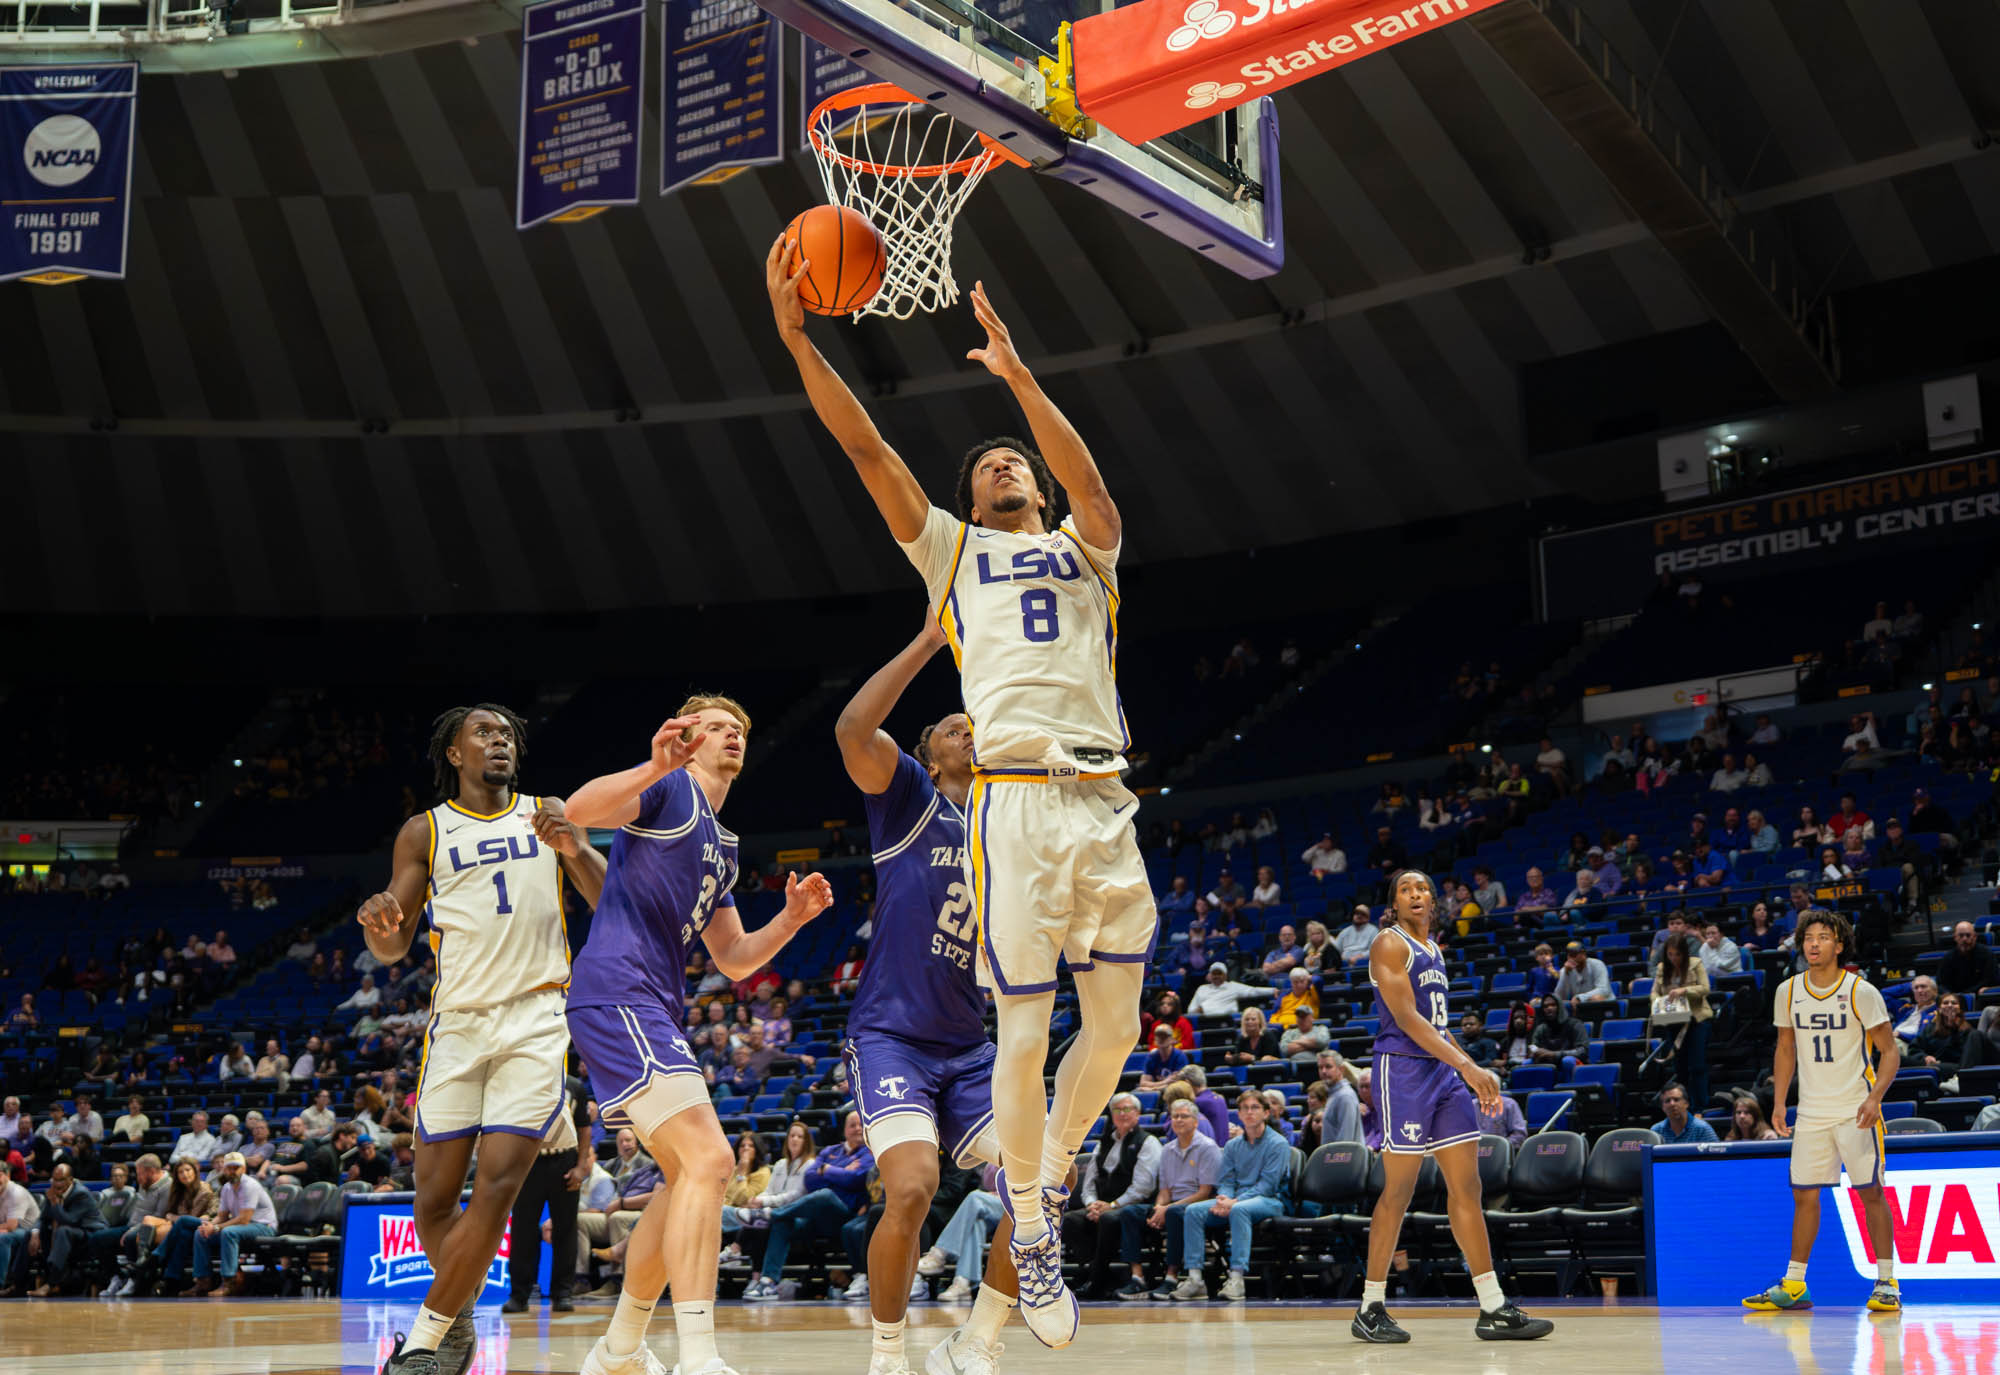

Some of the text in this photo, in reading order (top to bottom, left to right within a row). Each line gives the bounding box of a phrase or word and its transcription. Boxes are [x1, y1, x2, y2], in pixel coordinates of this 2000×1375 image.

[684, 4, 760, 41] CHAMPIONS
[543, 61, 623, 100] BREAUX
[32, 149, 97, 168] NCAA
[15, 211, 100, 229] FINAL FOUR
[30, 230, 82, 254] 1991
[1653, 458, 1999, 546] PETE MARAVICH
[1654, 491, 2000, 576] ASSEMBLY CENTER
[977, 548, 1081, 584] LSU
[1020, 588, 1059, 642] 8
[1052, 767, 1076, 777] LSU
[448, 834, 539, 872] LSU
[492, 870, 512, 914] 1
[937, 881, 977, 942] 21
[1430, 991, 1448, 1026] 13
[1795, 1013, 1847, 1030] LSU
[1813, 1035, 1834, 1062] 11
[382, 1219, 425, 1260] WA
[1847, 1183, 2000, 1264] WA
